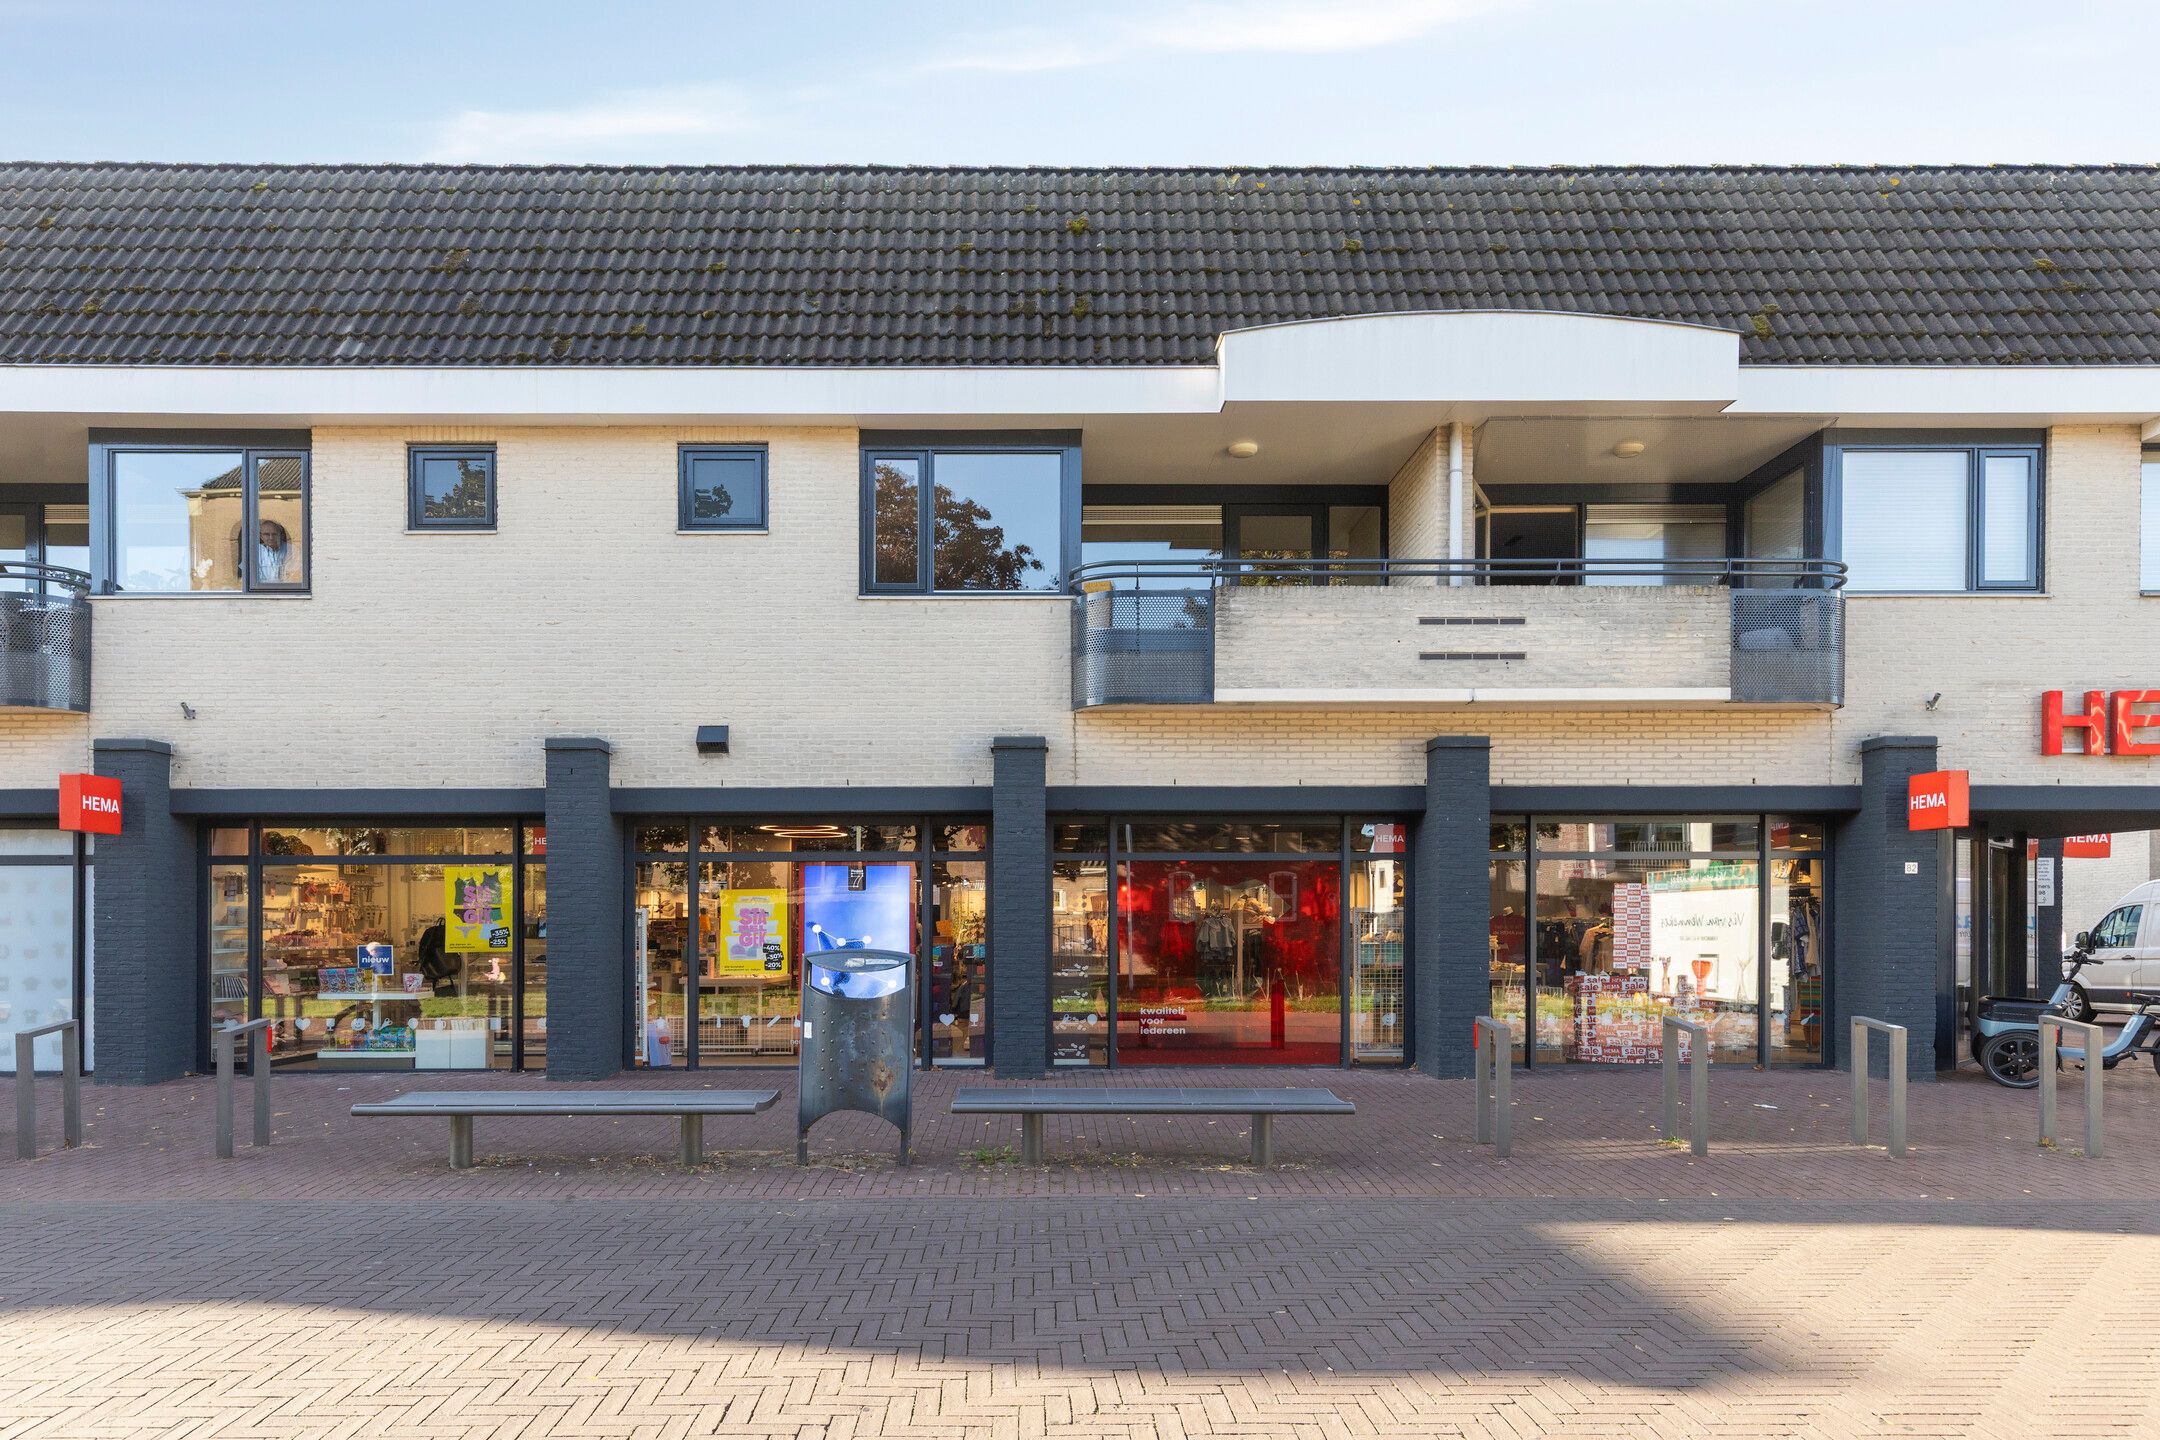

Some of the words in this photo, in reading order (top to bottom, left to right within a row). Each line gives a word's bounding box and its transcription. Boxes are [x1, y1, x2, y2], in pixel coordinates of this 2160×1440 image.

[82, 795, 120, 814] HEMA
[1911, 792, 1946, 810] HEMA
[1140, 1006, 1185, 1014] kwaliteit
[1140, 1026, 1186, 1034] iedereen
